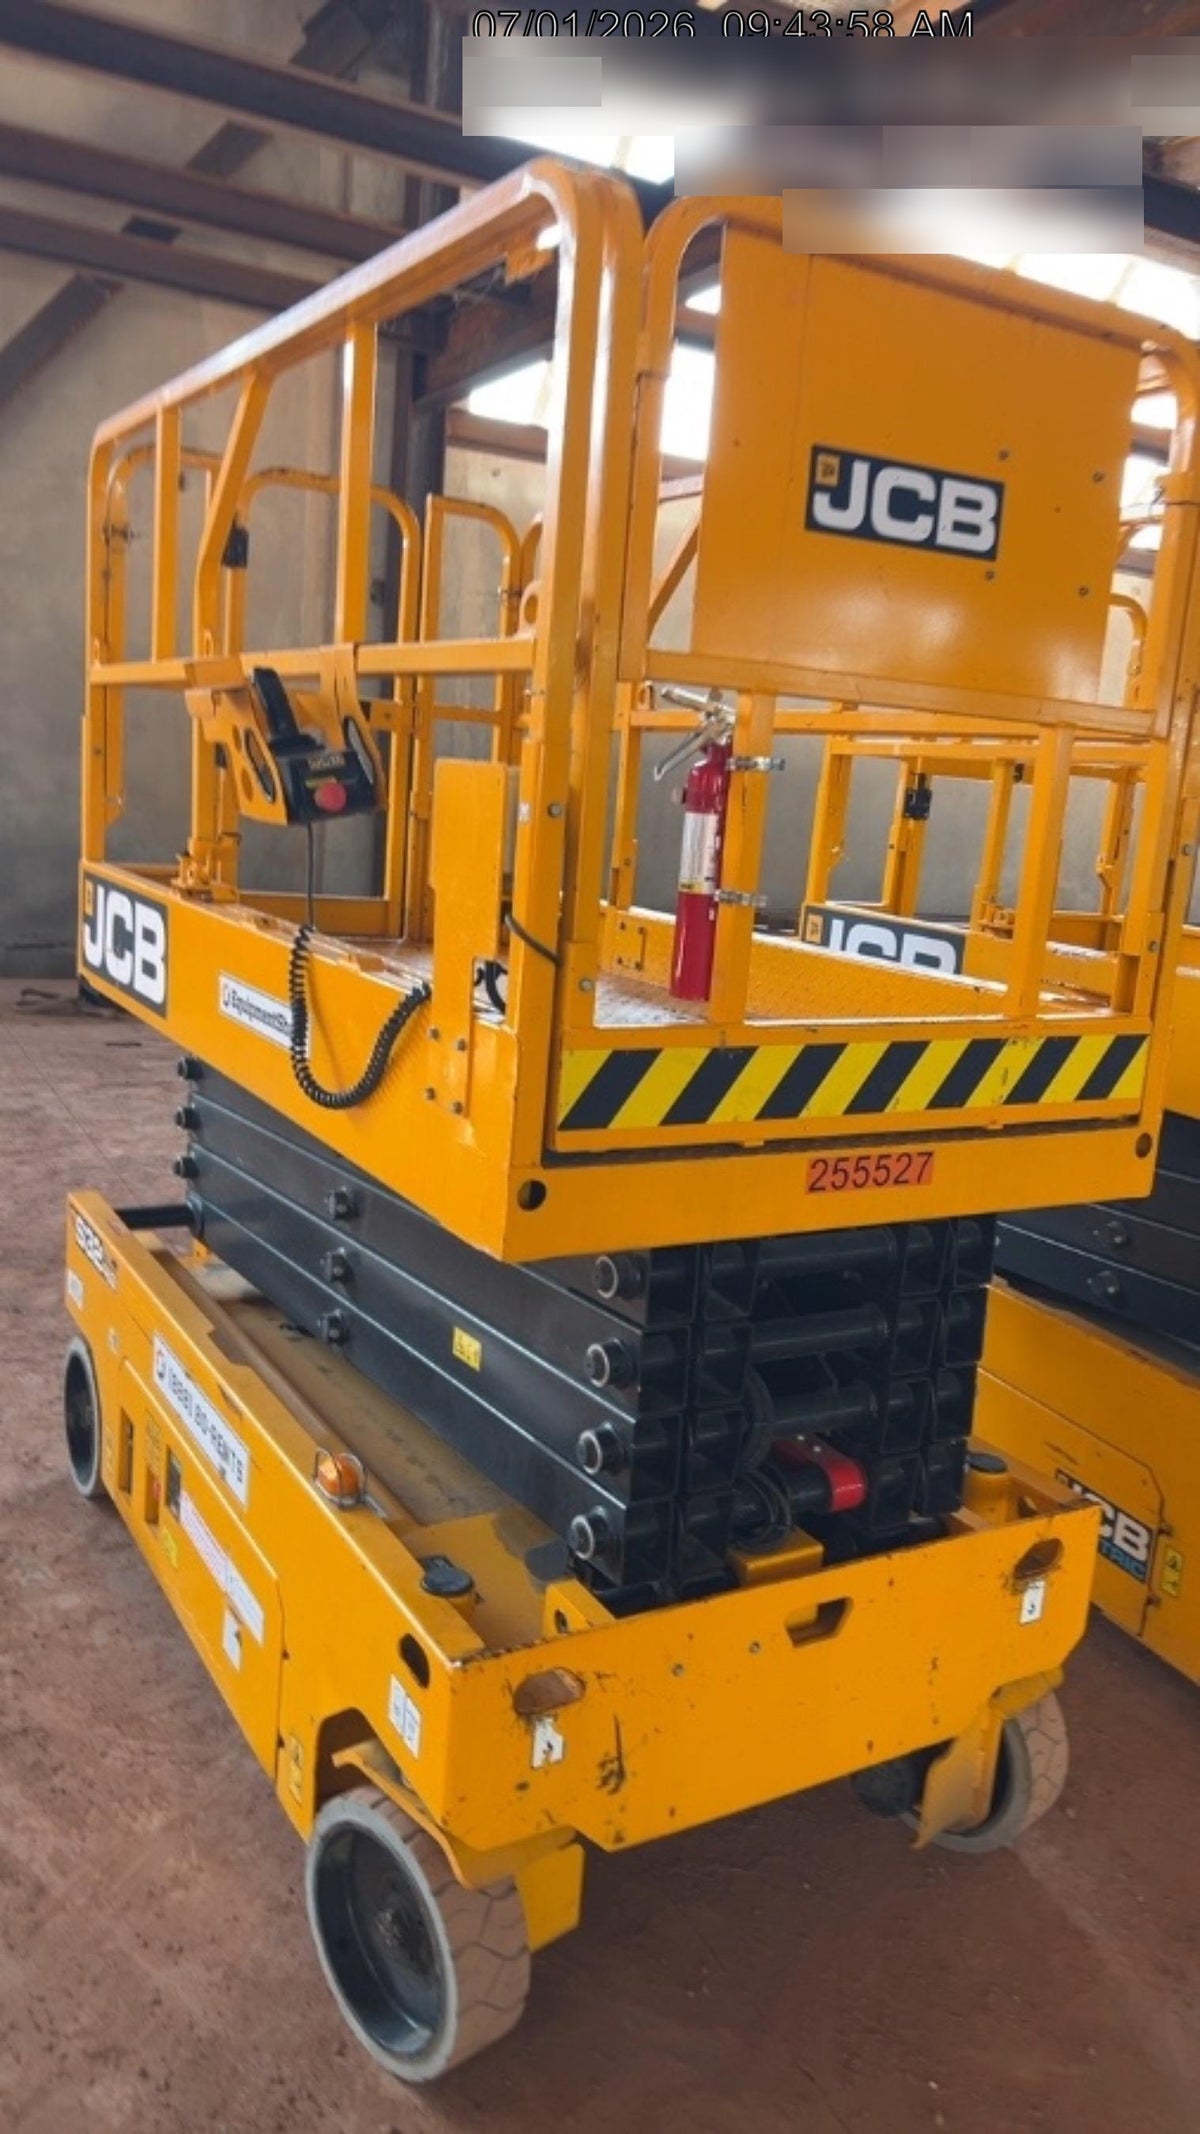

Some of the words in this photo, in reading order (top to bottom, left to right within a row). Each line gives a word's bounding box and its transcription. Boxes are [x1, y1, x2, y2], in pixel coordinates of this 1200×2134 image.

[812, 459, 998, 553] JCB
[83, 882, 167, 1005] JCB
[808, 1152, 934, 1192] 255527
